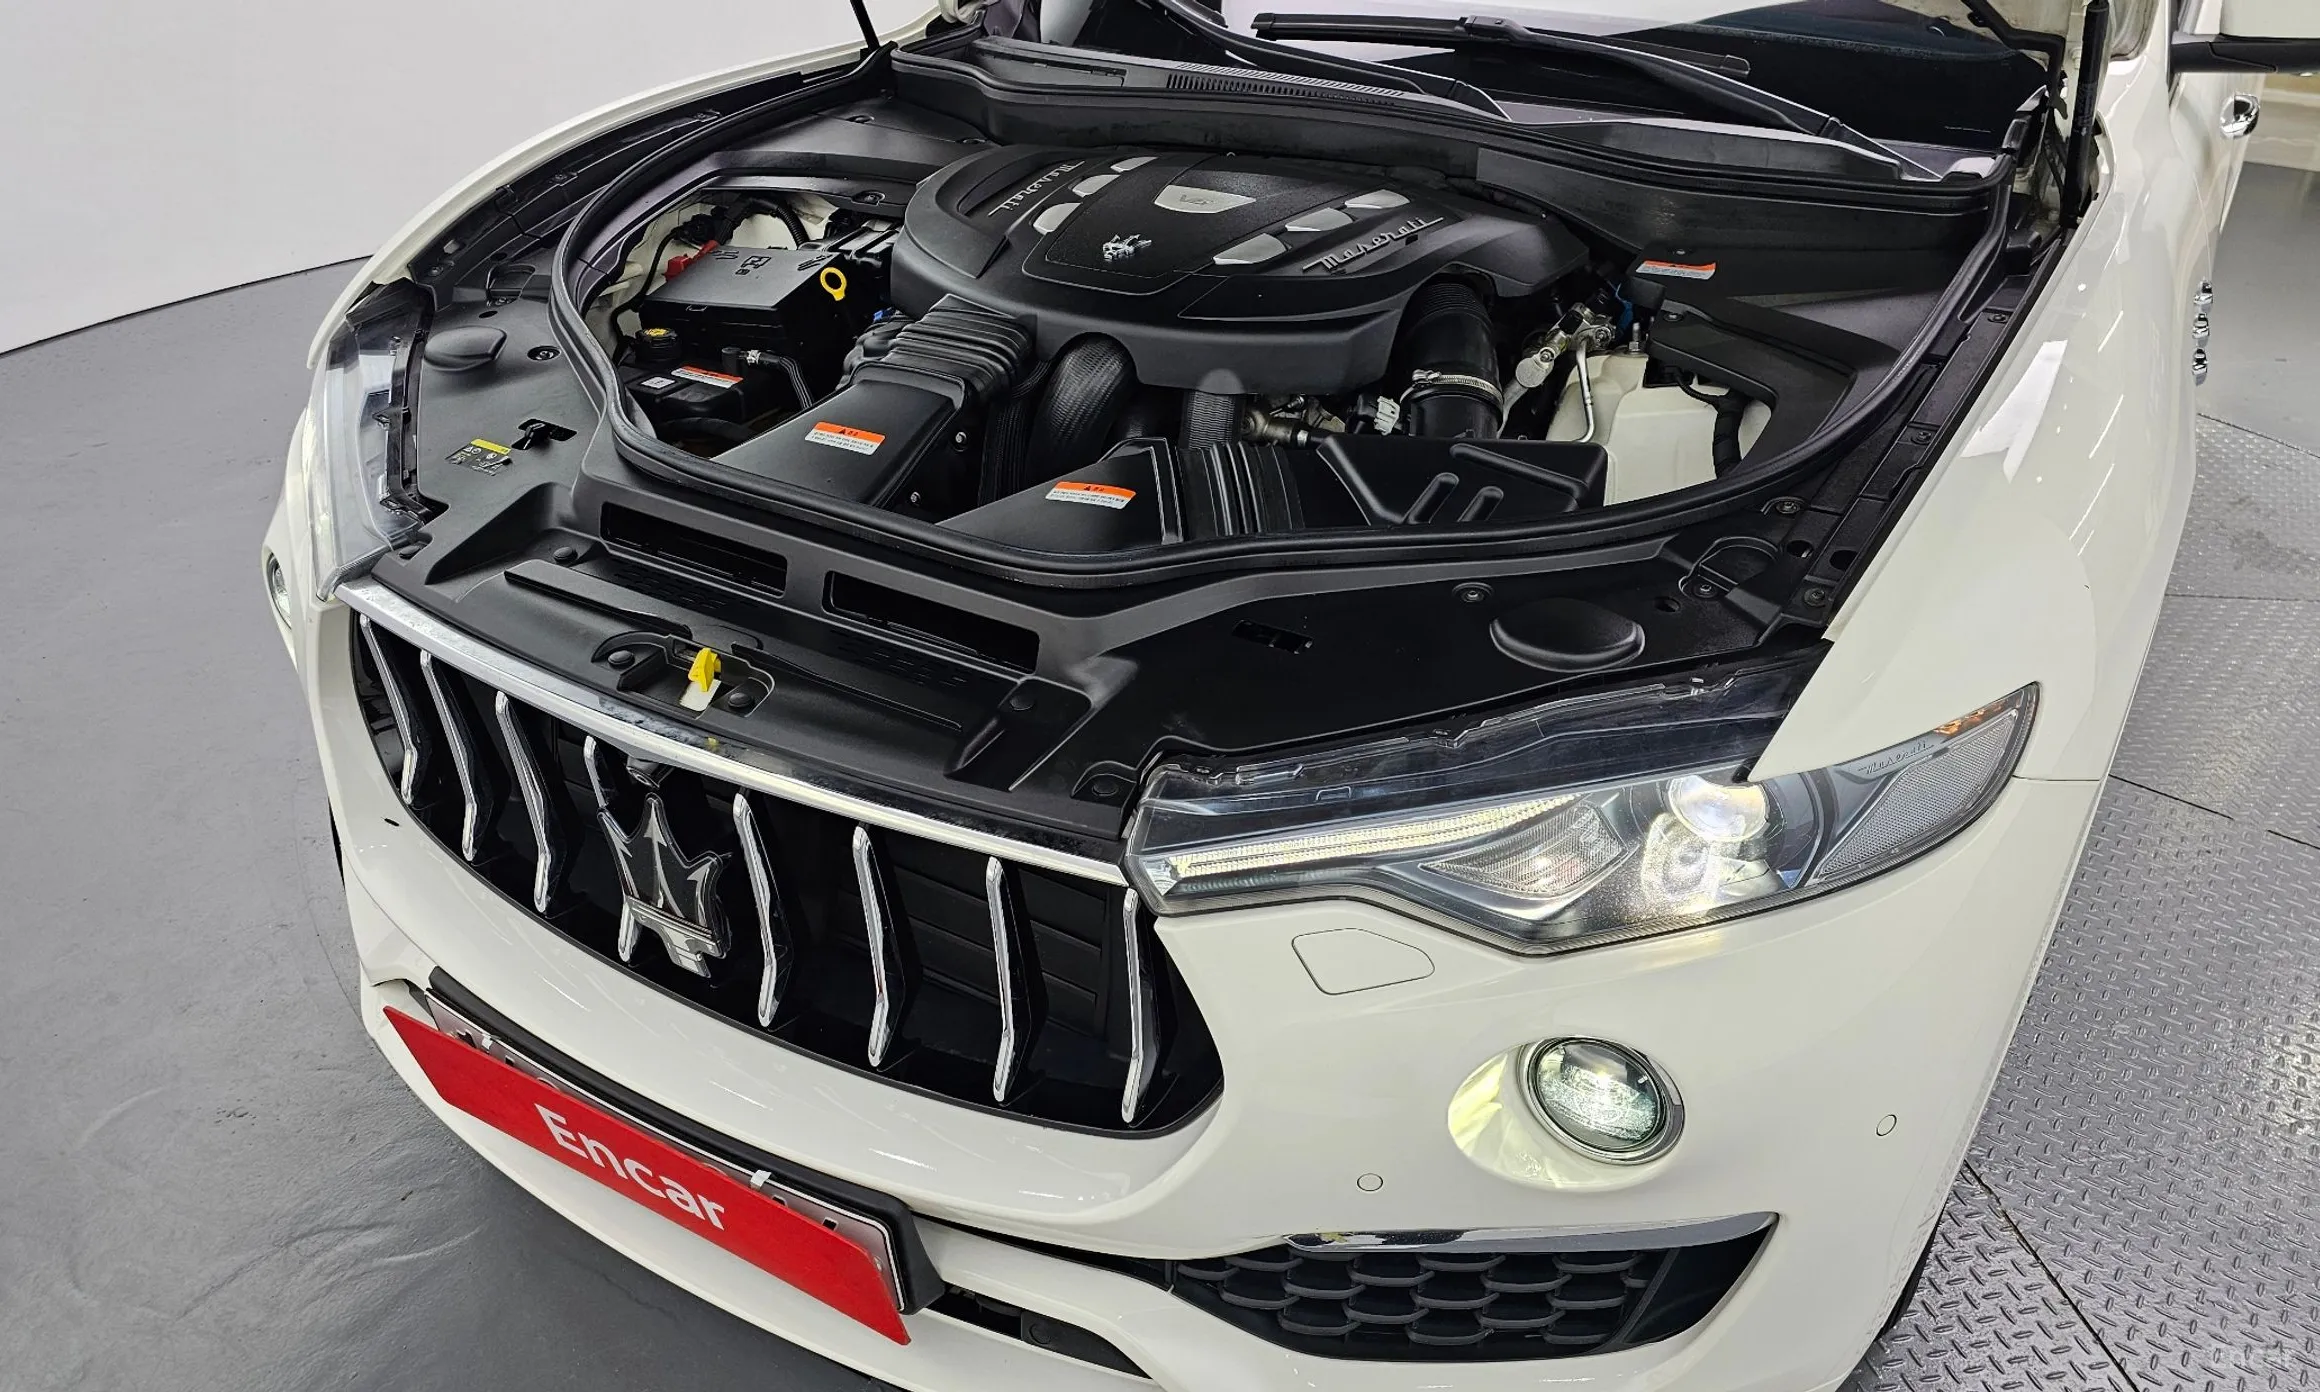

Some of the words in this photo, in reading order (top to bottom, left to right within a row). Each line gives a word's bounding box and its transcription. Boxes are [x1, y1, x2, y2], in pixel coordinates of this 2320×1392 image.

[987, 160, 1085, 217] Maserati
[1302, 216, 1444, 271] Maserati
[1857, 738, 1935, 775] Maserati
[533, 1103, 725, 1231] Encar
